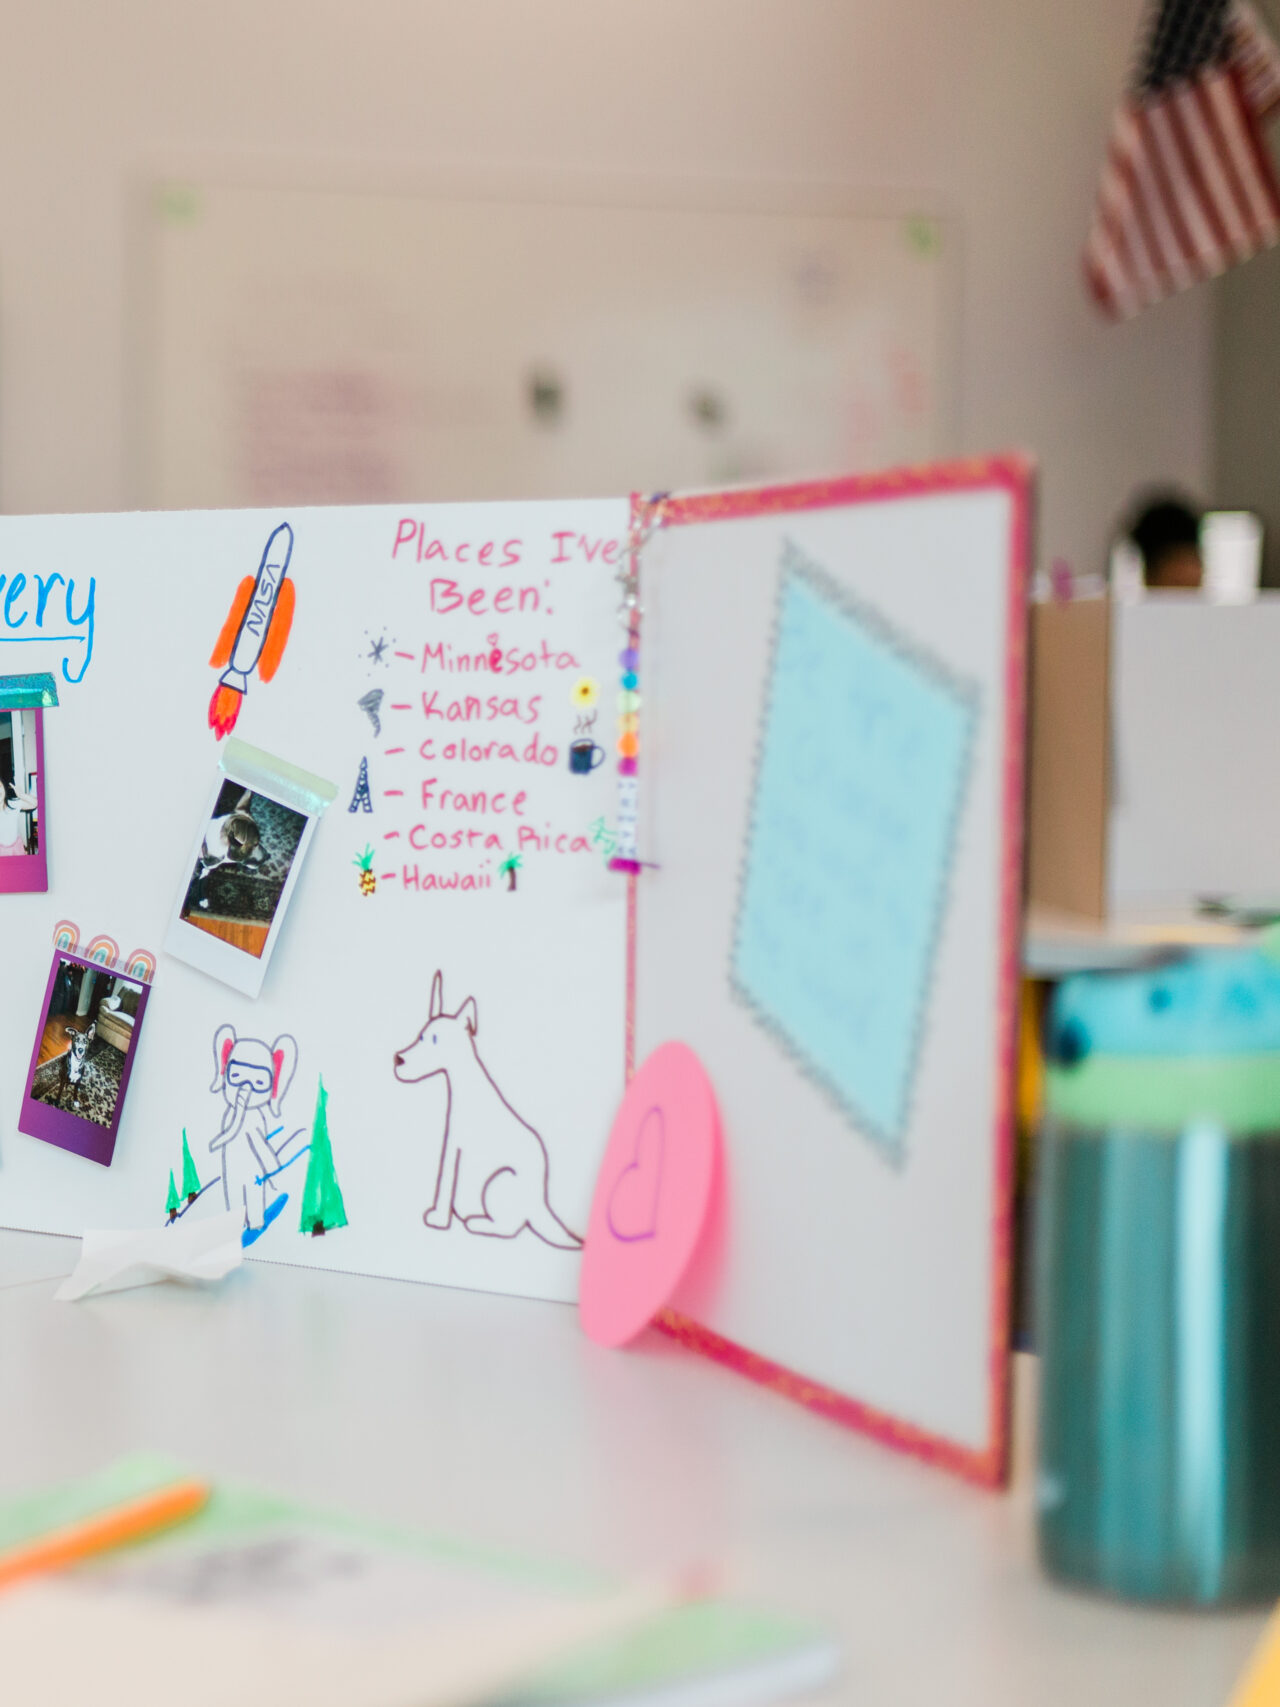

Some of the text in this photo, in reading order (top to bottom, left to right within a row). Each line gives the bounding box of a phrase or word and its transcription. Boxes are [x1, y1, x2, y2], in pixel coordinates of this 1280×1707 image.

[392, 518, 619, 567] Places I've
[246, 563, 280, 637] NASA
[430, 578, 553, 615] Been:
[518, 821, 592, 852] Rica
